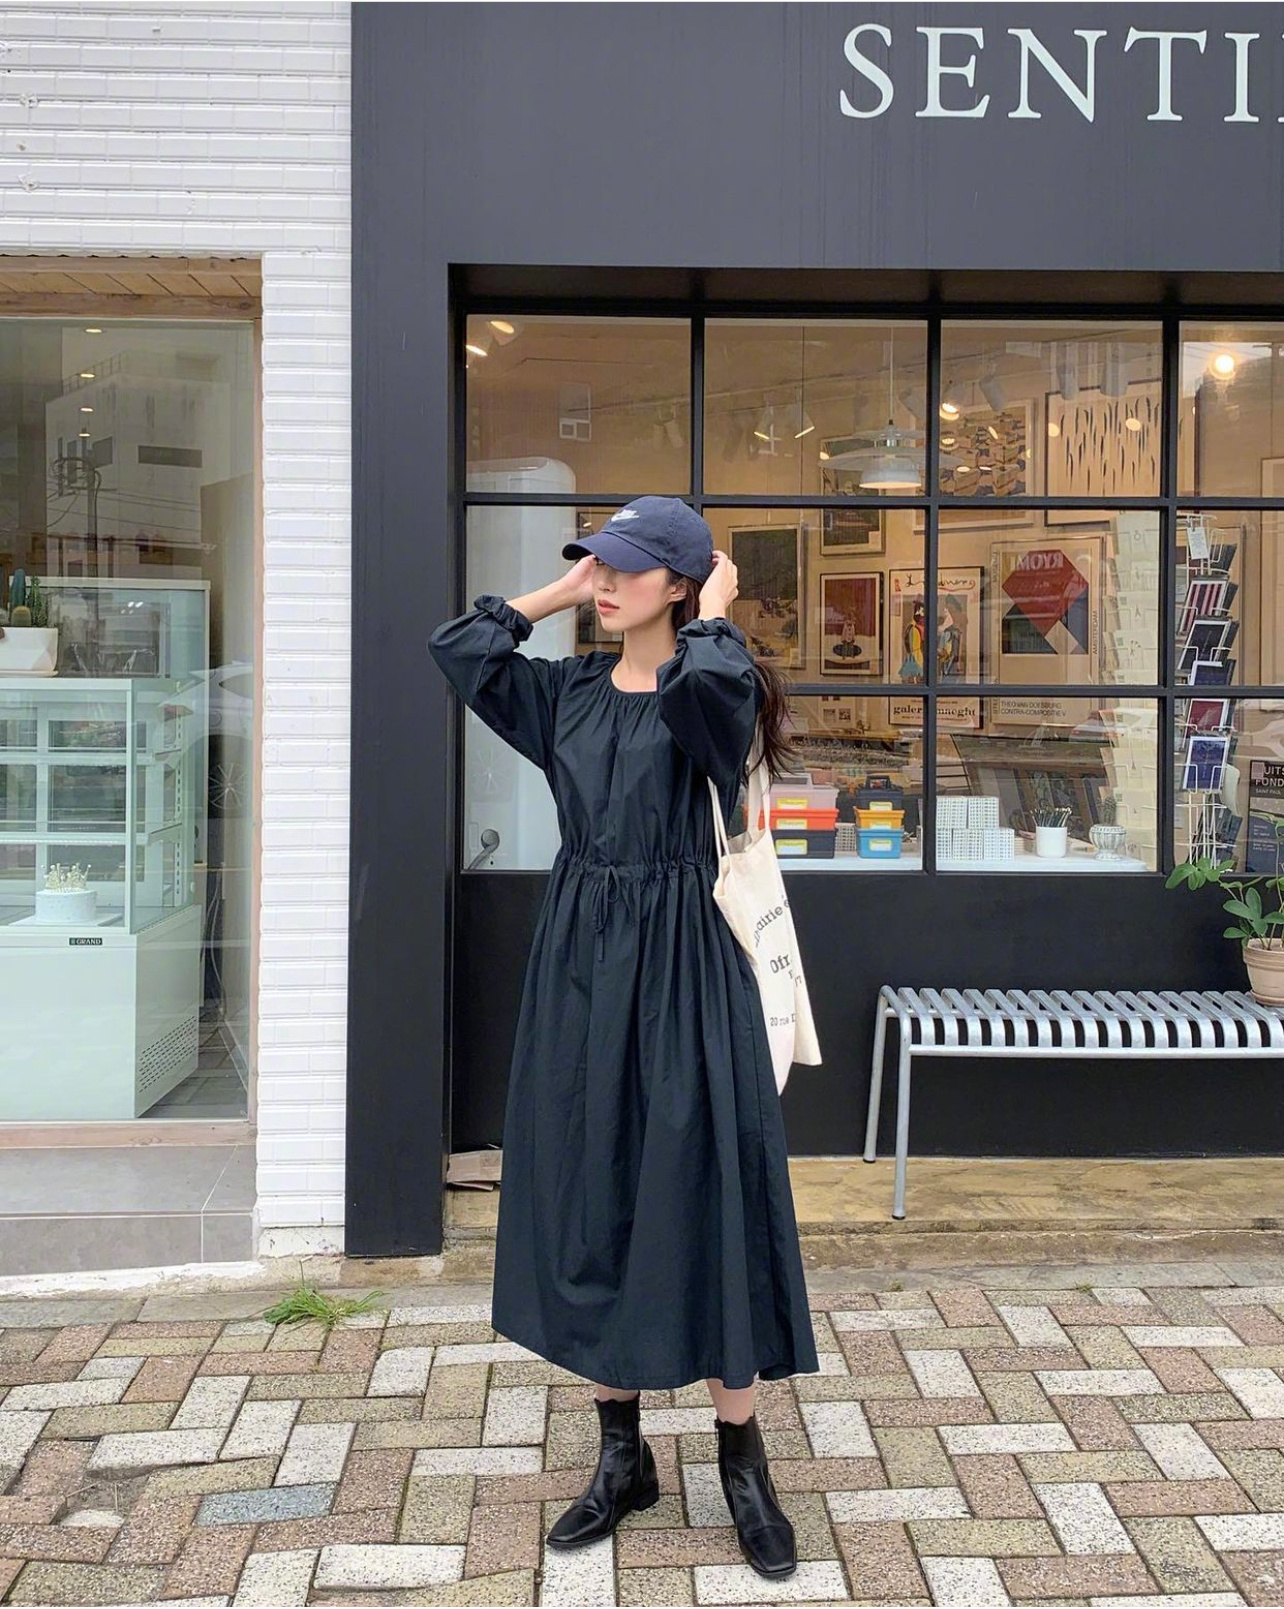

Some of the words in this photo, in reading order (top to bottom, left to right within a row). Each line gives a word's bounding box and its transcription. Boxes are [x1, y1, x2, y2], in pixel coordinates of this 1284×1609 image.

[840, 23, 1284, 122] SENTI
[893, 705, 922, 715] galer
[77, 937, 101, 946] GRAND
